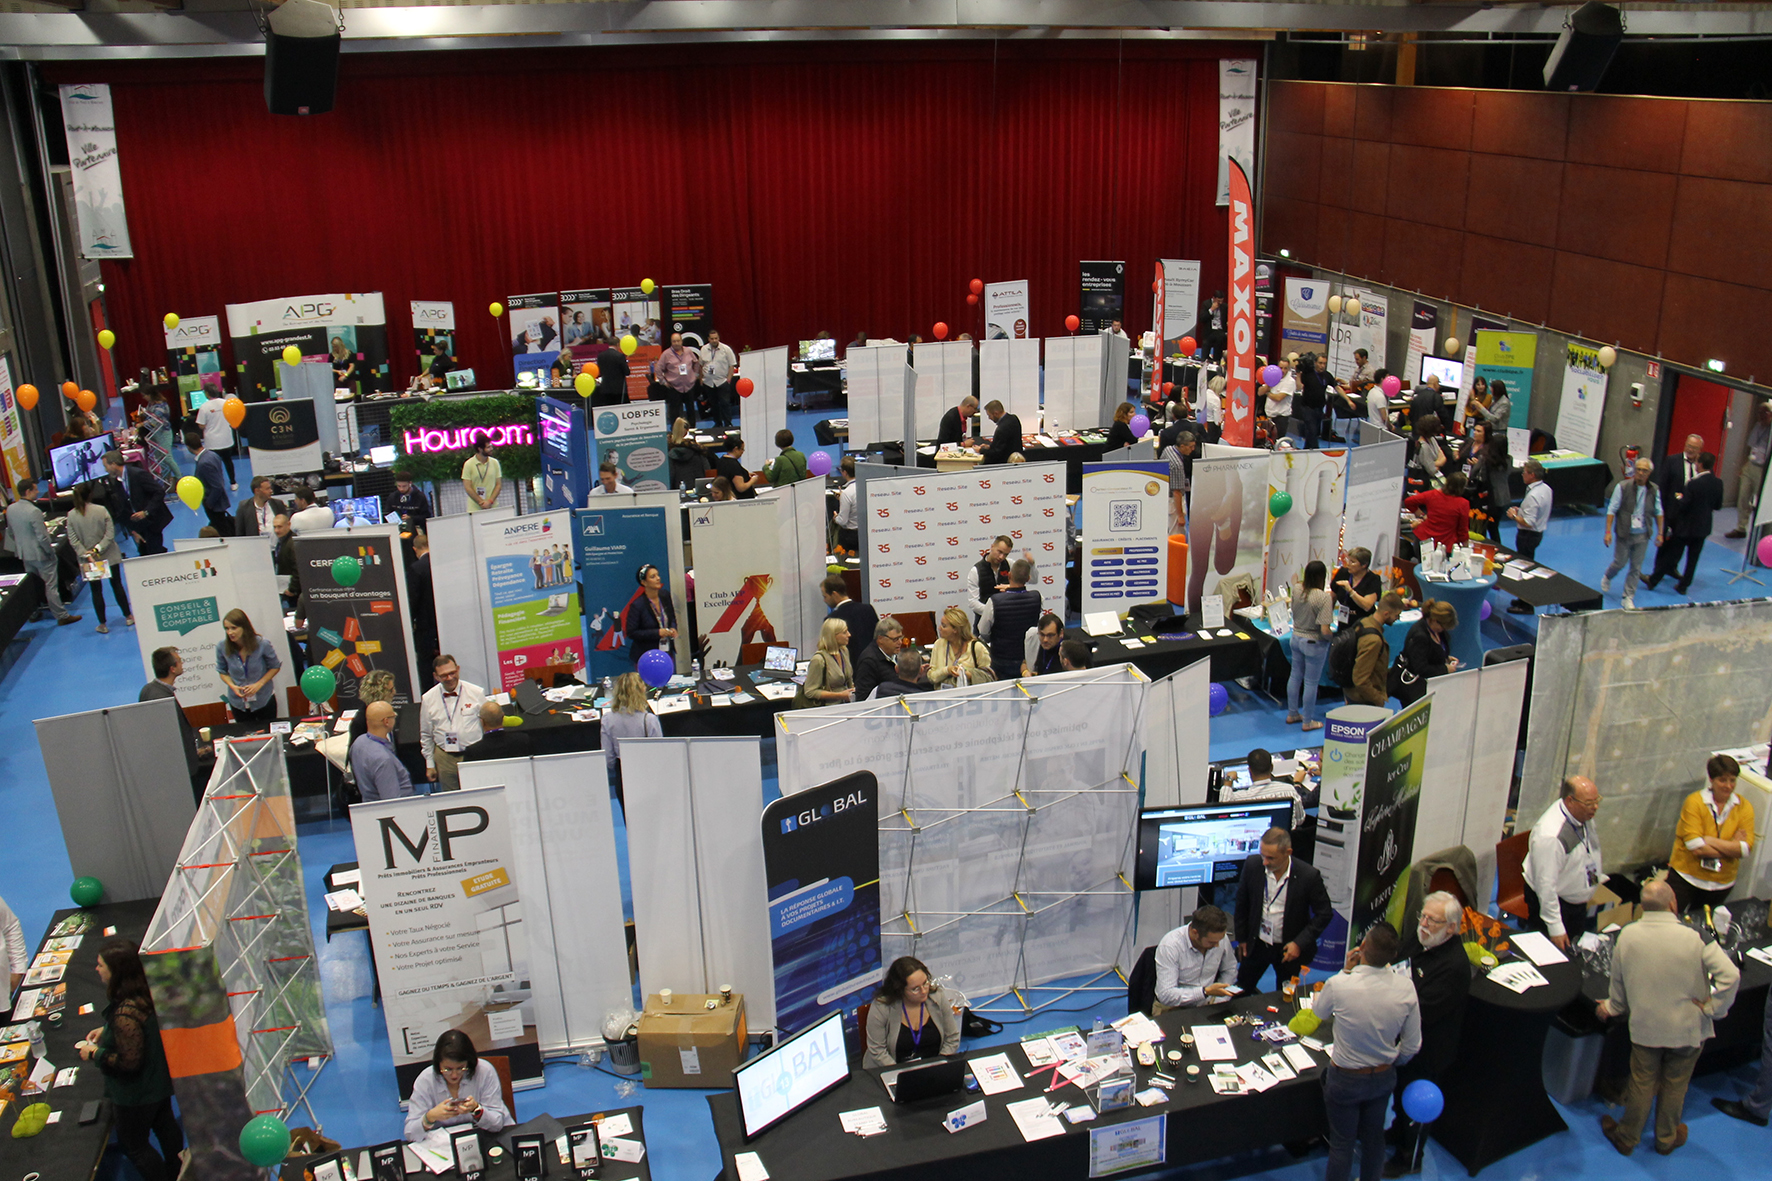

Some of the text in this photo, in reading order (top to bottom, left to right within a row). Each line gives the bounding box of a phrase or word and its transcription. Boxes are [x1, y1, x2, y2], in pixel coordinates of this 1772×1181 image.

[81, 142, 99, 155] Ville
[72, 147, 118, 168] Partenaire
[282, 302, 337, 320] APG
[420, 310, 448, 319] APG
[176, 325, 212, 337] APG
[622, 409, 660, 420] LOB'PSE
[271, 425, 294, 434] C3N
[693, 517, 710, 525] AXA
[504, 522, 540, 535] ANPERE
[583, 526, 600, 534] AXA
[491, 562, 513, 570] Épargne
[142, 572, 199, 588] CERFRANCE
[492, 573, 523, 582] Prévoyance
[493, 578, 526, 588] Dépendance
[710, 591, 728, 599] Club
[160, 602, 201, 614] CONSEIL
[703, 600, 745, 608] Excellence
[161, 607, 212, 621] EXPERTISE
[162, 615, 214, 628] COMPTABLE
[499, 616, 526, 625] Financière
[1331, 724, 1365, 736] EPSON
[1371, 710, 1429, 758] CHAMPAGNE
[427, 811, 441, 863] FINANCE
[394, 868, 426, 878] Immobiliers
[432, 863, 463, 872] Assurances
[464, 858, 499, 868] Emprunteurs
[427, 868, 467, 878] Professionnels
[473, 873, 494, 884] ETUDE
[471, 878, 502, 893] GRATUITE
[398, 888, 436, 898] RENCONTREZ
[789, 896, 817, 911] RÉPONSE
[817, 885, 843, 900] GLOBALE
[394, 898, 418, 907] DIZAINE
[427, 894, 456, 902] BANQUES
[781, 903, 831, 928] DOCUMENTAIRES
[786, 900, 824, 919] VOS PROJETS
[390, 922, 451, 936] Votre Taux Négocié
[393, 940, 410, 948] Votre
[411, 935, 444, 945] Assurance
[457, 931, 481, 939] mesure
[409, 948, 433, 958] Experts
[440, 944, 456, 952] votre
[457, 941, 480, 950] Service
[396, 955, 463, 971] Votre Projet optimisé
[456, 979, 478, 987] GAGNEZ
[487, 974, 513, 982] L'ARGENT
[462, 1144, 473, 1152] MP
[523, 1150, 535, 1158] MP
[381, 1157, 394, 1166] MP
[466, 1173, 480, 1181] MP
[581, 1169, 595, 1178] MP
